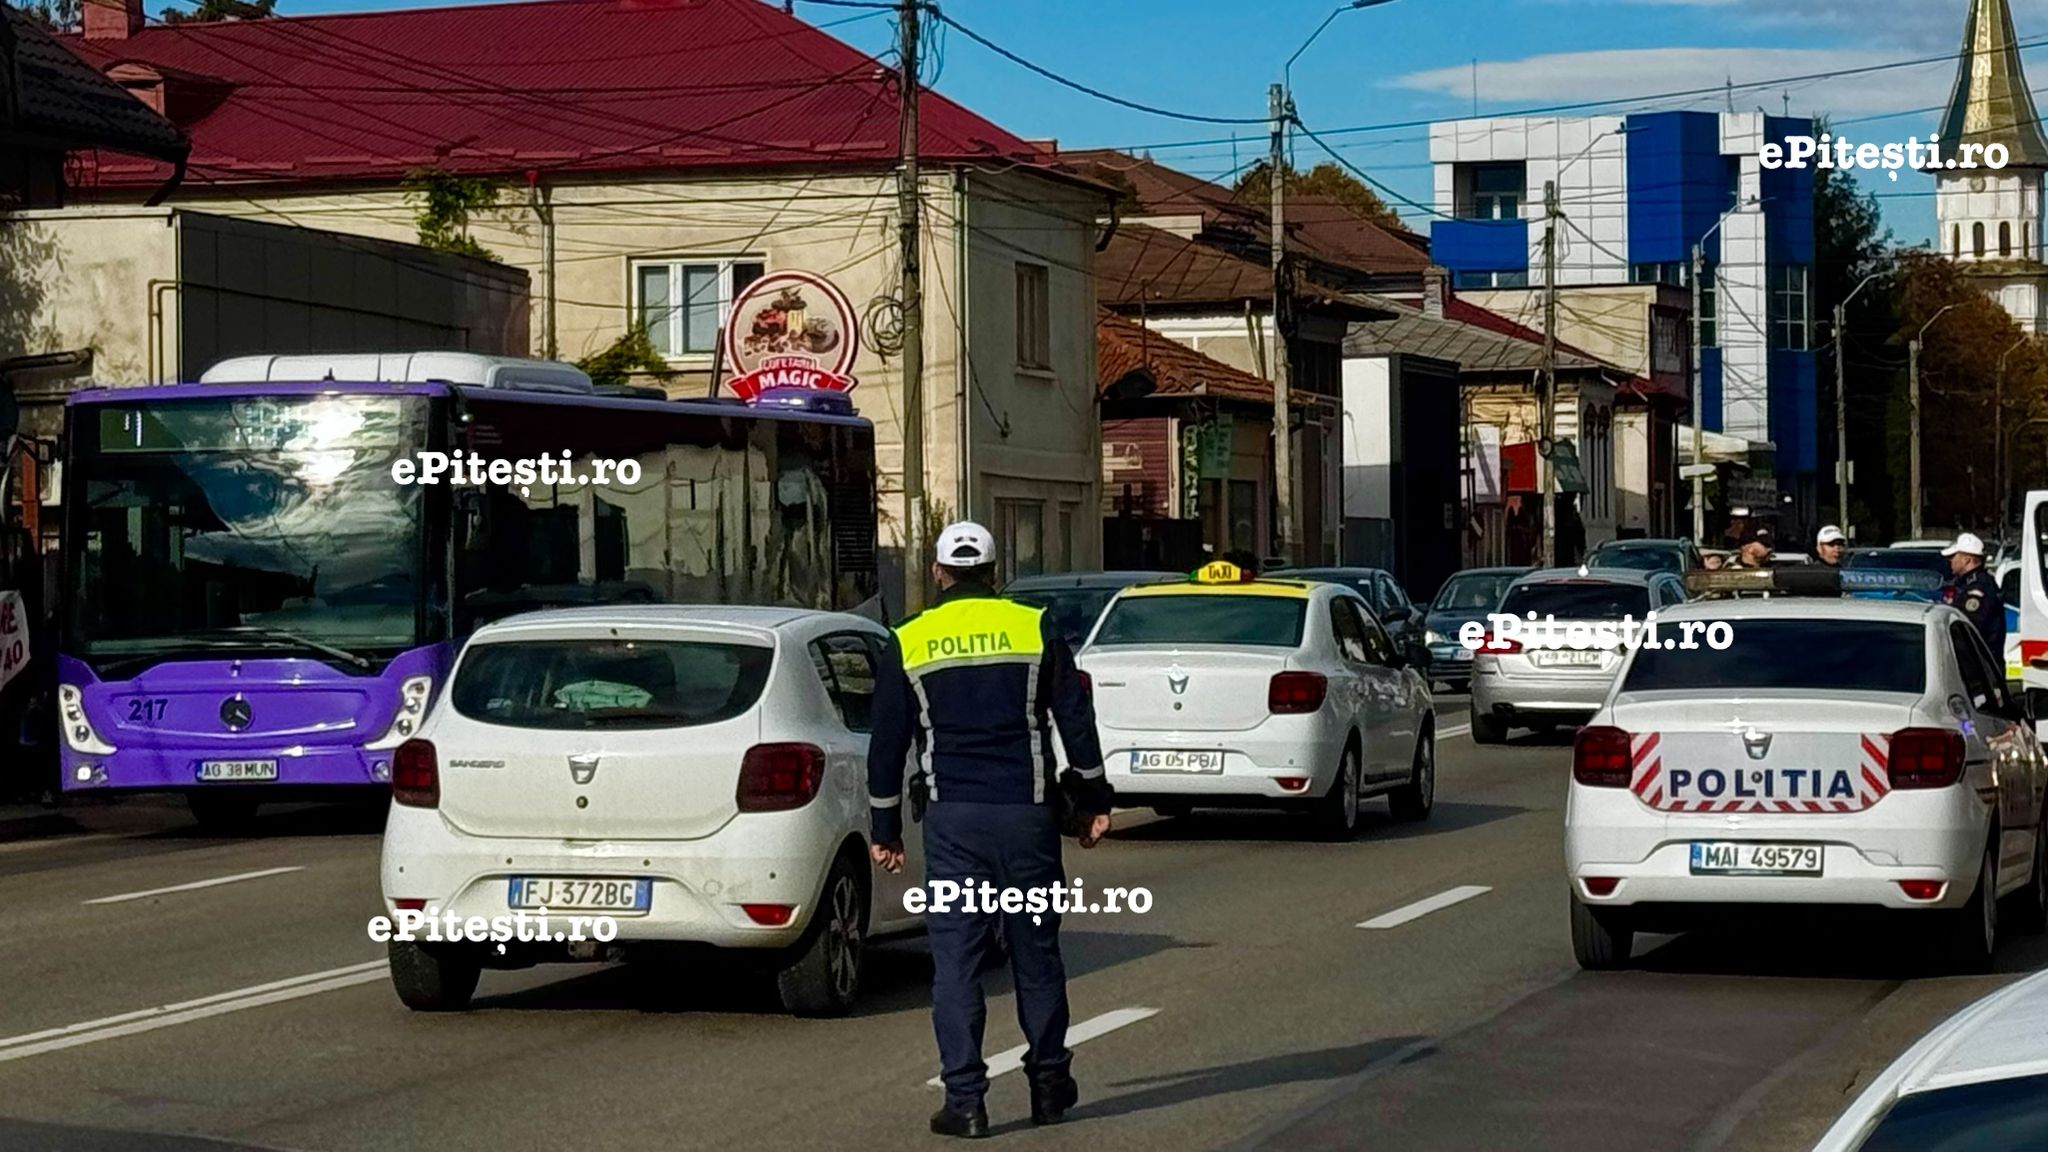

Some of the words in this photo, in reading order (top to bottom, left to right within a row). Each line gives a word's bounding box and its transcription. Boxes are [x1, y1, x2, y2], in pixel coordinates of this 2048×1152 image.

[758, 370, 823, 390] MAGIC
[1208, 564, 1232, 580] TAXI
[927, 631, 1012, 659] POLITIA
[128, 699, 168, 721] 217
[244, 763, 274, 776] MUN
[1142, 754, 1161, 767] AG
[1669, 769, 1855, 798] POLITIA
[1705, 847, 1739, 867] MAI
[1751, 847, 1817, 868] 49579
[526, 881, 553, 904] FJ
[562, 881, 632, 905] 372BG
